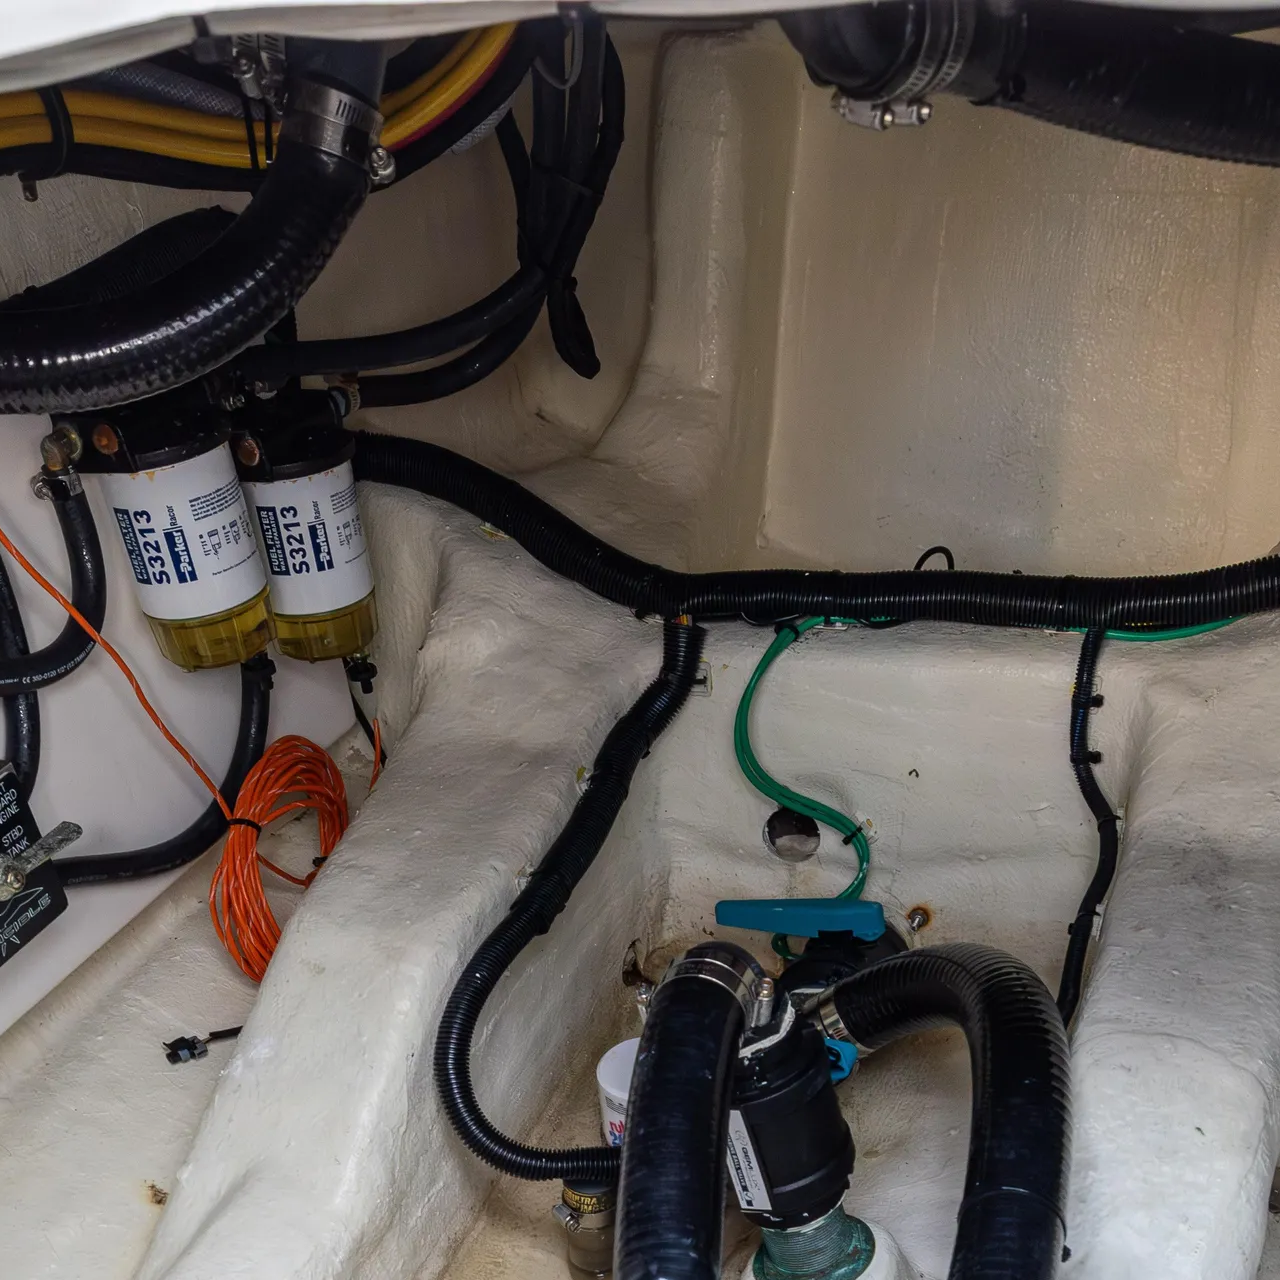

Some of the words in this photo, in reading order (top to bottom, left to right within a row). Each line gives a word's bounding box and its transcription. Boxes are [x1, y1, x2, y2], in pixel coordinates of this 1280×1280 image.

[166, 505, 179, 527] Racor
[312, 500, 322, 520] Racor
[117, 513, 133, 550] FILTER
[123, 514, 140, 555] SEPARATOR
[260, 510, 274, 545] FILTER
[268, 511, 281, 549] SEPARATOR
[280, 506, 311, 574] S3213
[315, 524, 331, 562] Parker
[133, 510, 171, 585] S3213
[172, 531, 193, 573] Parker
[269, 547, 281, 571] FUEL
[276, 549, 286, 571] WATER
[131, 552, 144, 580] FUEL
[137, 556, 148, 580] WATER
[2, 825, 24, 847] STBD
[7, 836, 30, 859] TANK
